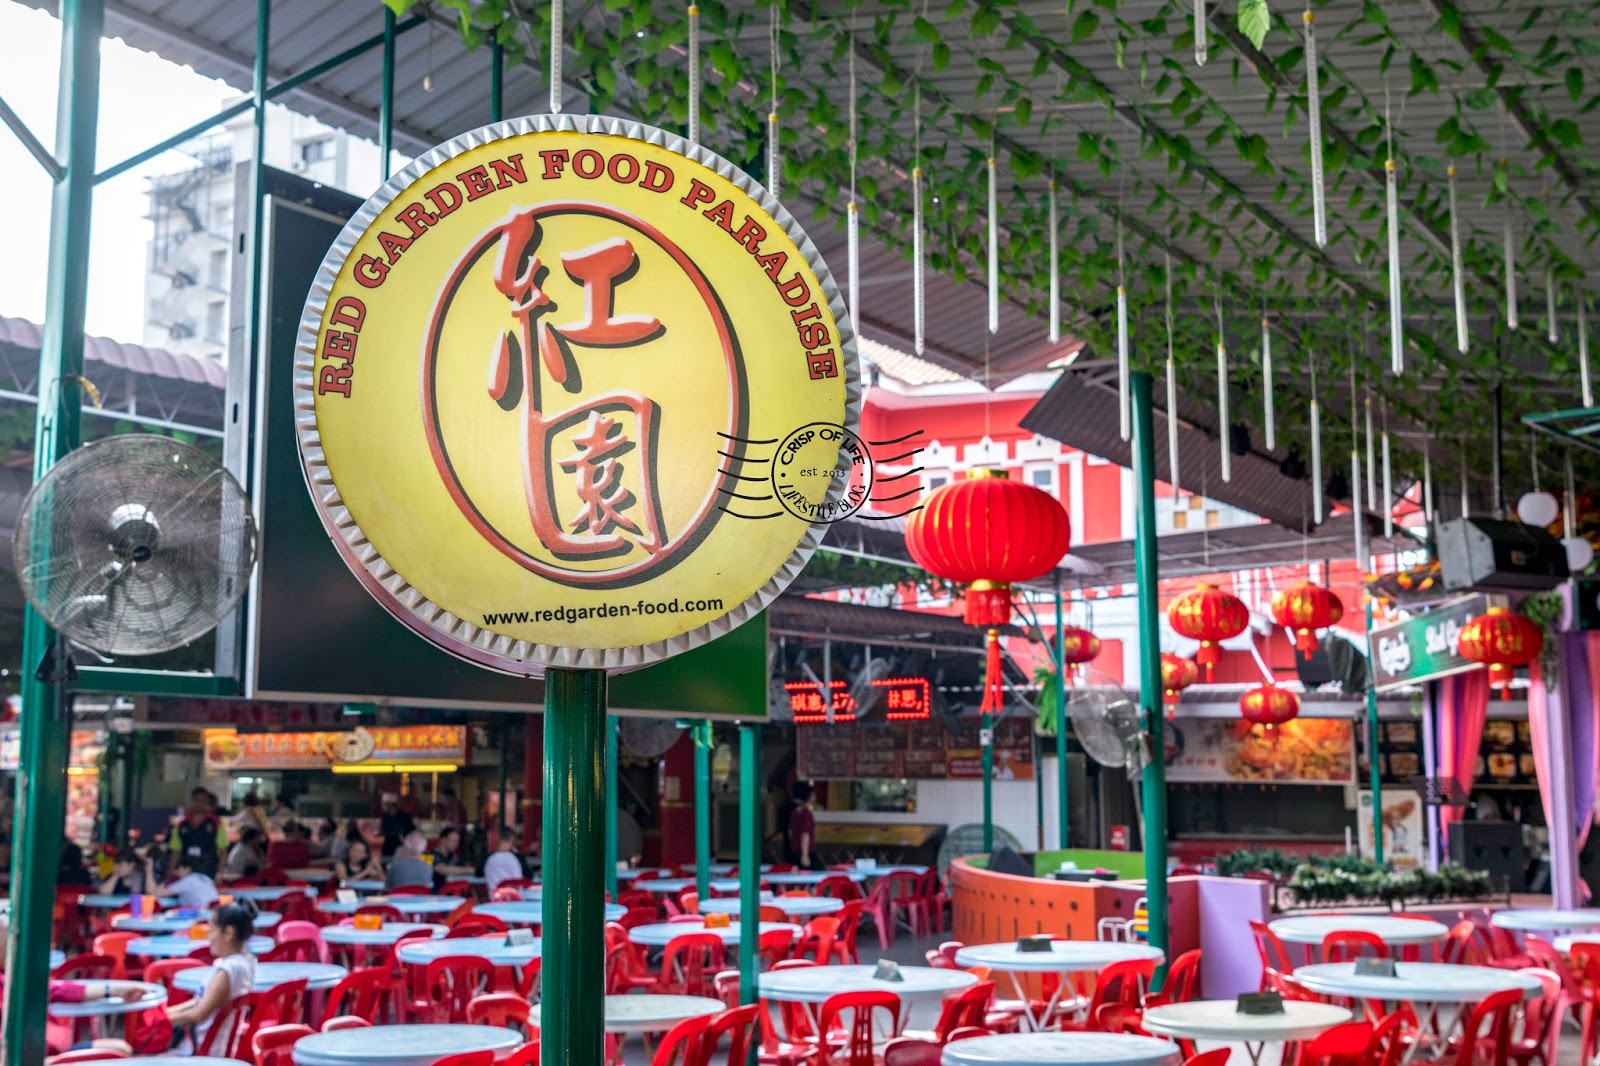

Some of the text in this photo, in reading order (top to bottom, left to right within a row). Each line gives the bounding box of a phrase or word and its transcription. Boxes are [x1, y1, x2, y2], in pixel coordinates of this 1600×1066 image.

[319, 149, 839, 398] RED GARDEN FOOD PARADISE
[483, 598, 724, 626] www.redgarden-food.com
